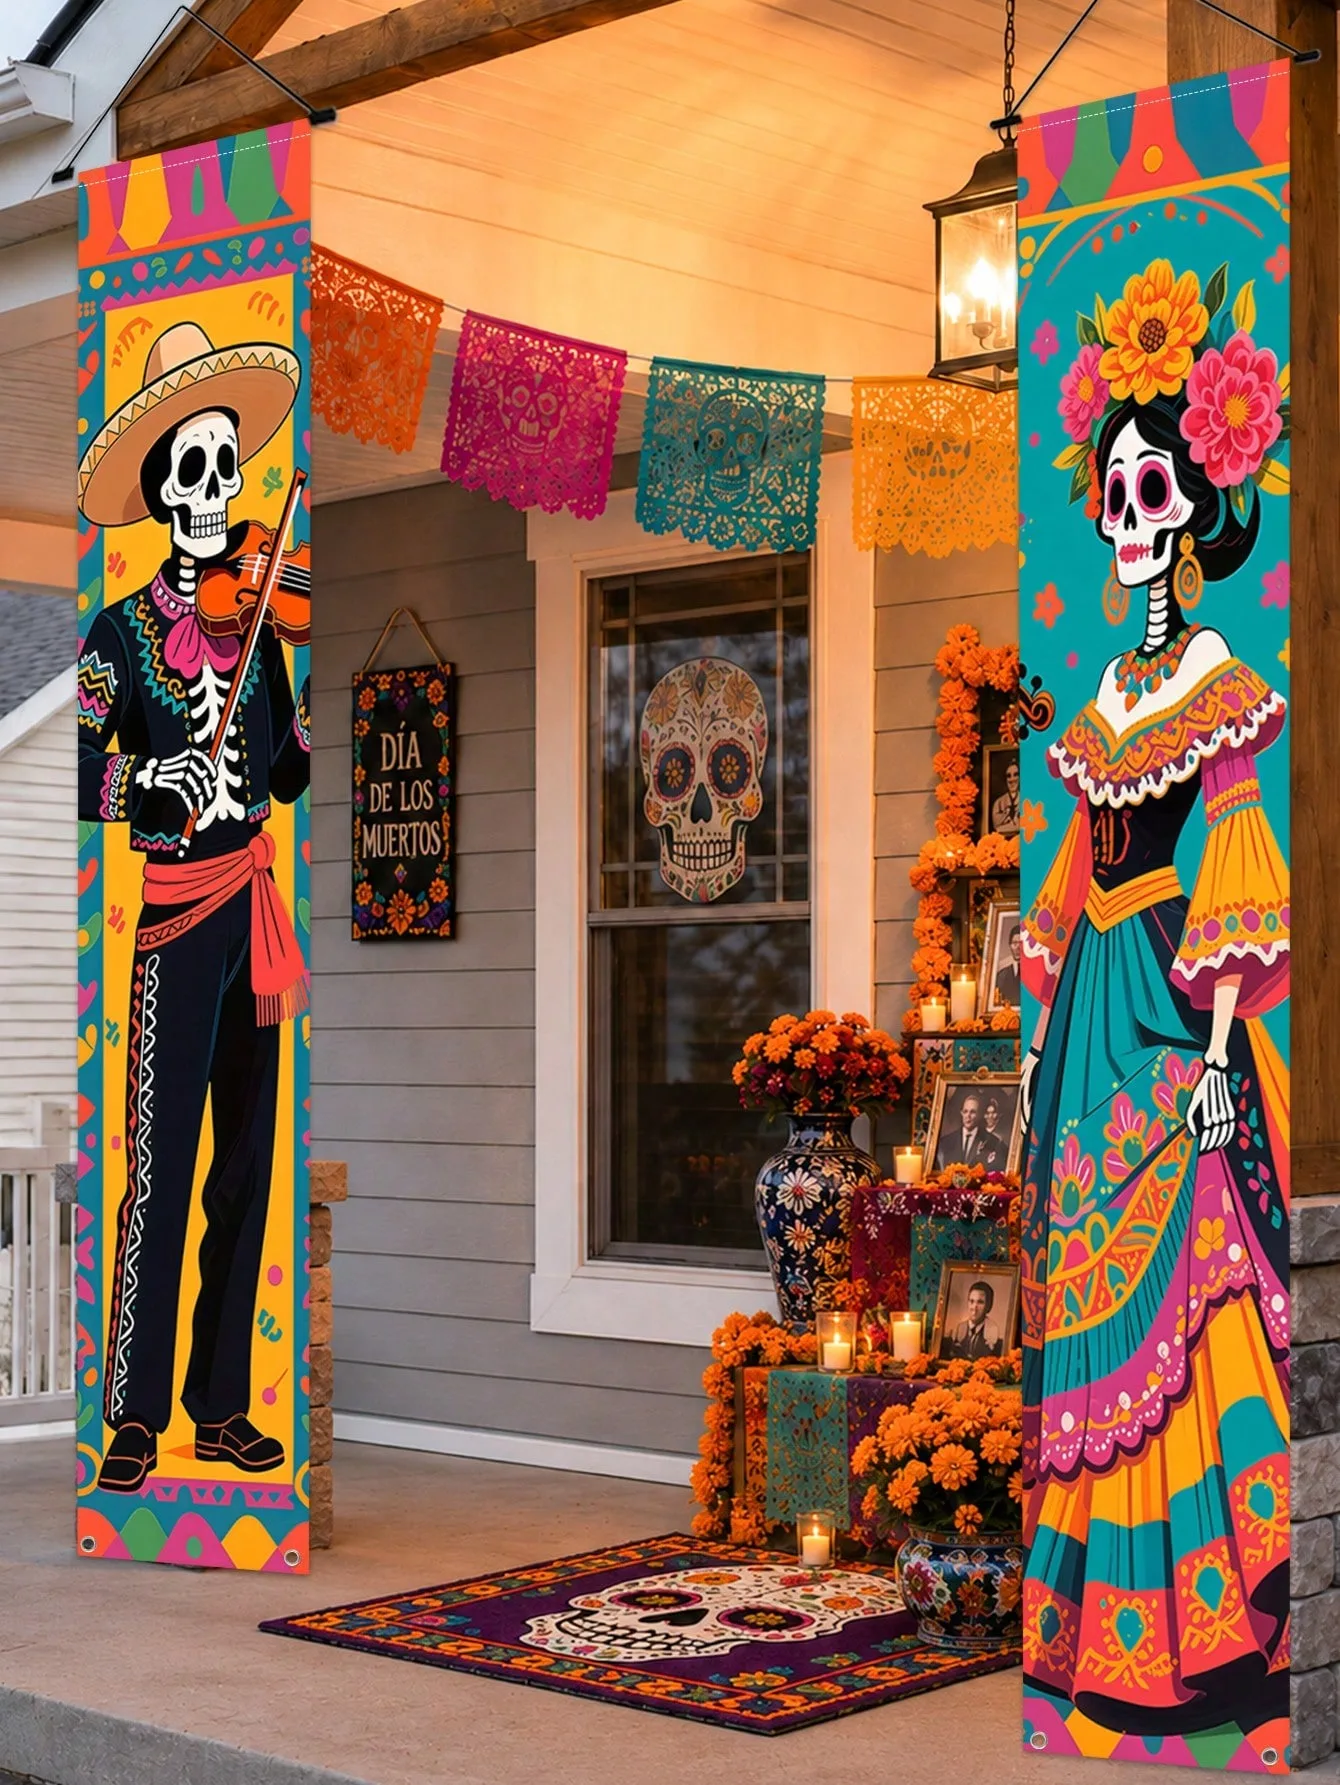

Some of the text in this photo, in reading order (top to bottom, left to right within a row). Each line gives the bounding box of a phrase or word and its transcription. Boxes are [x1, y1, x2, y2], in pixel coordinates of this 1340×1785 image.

[380, 721, 423, 772] DÍA
[369, 779, 434, 813] DE LOS
[362, 820, 442, 859] MUERTOS
